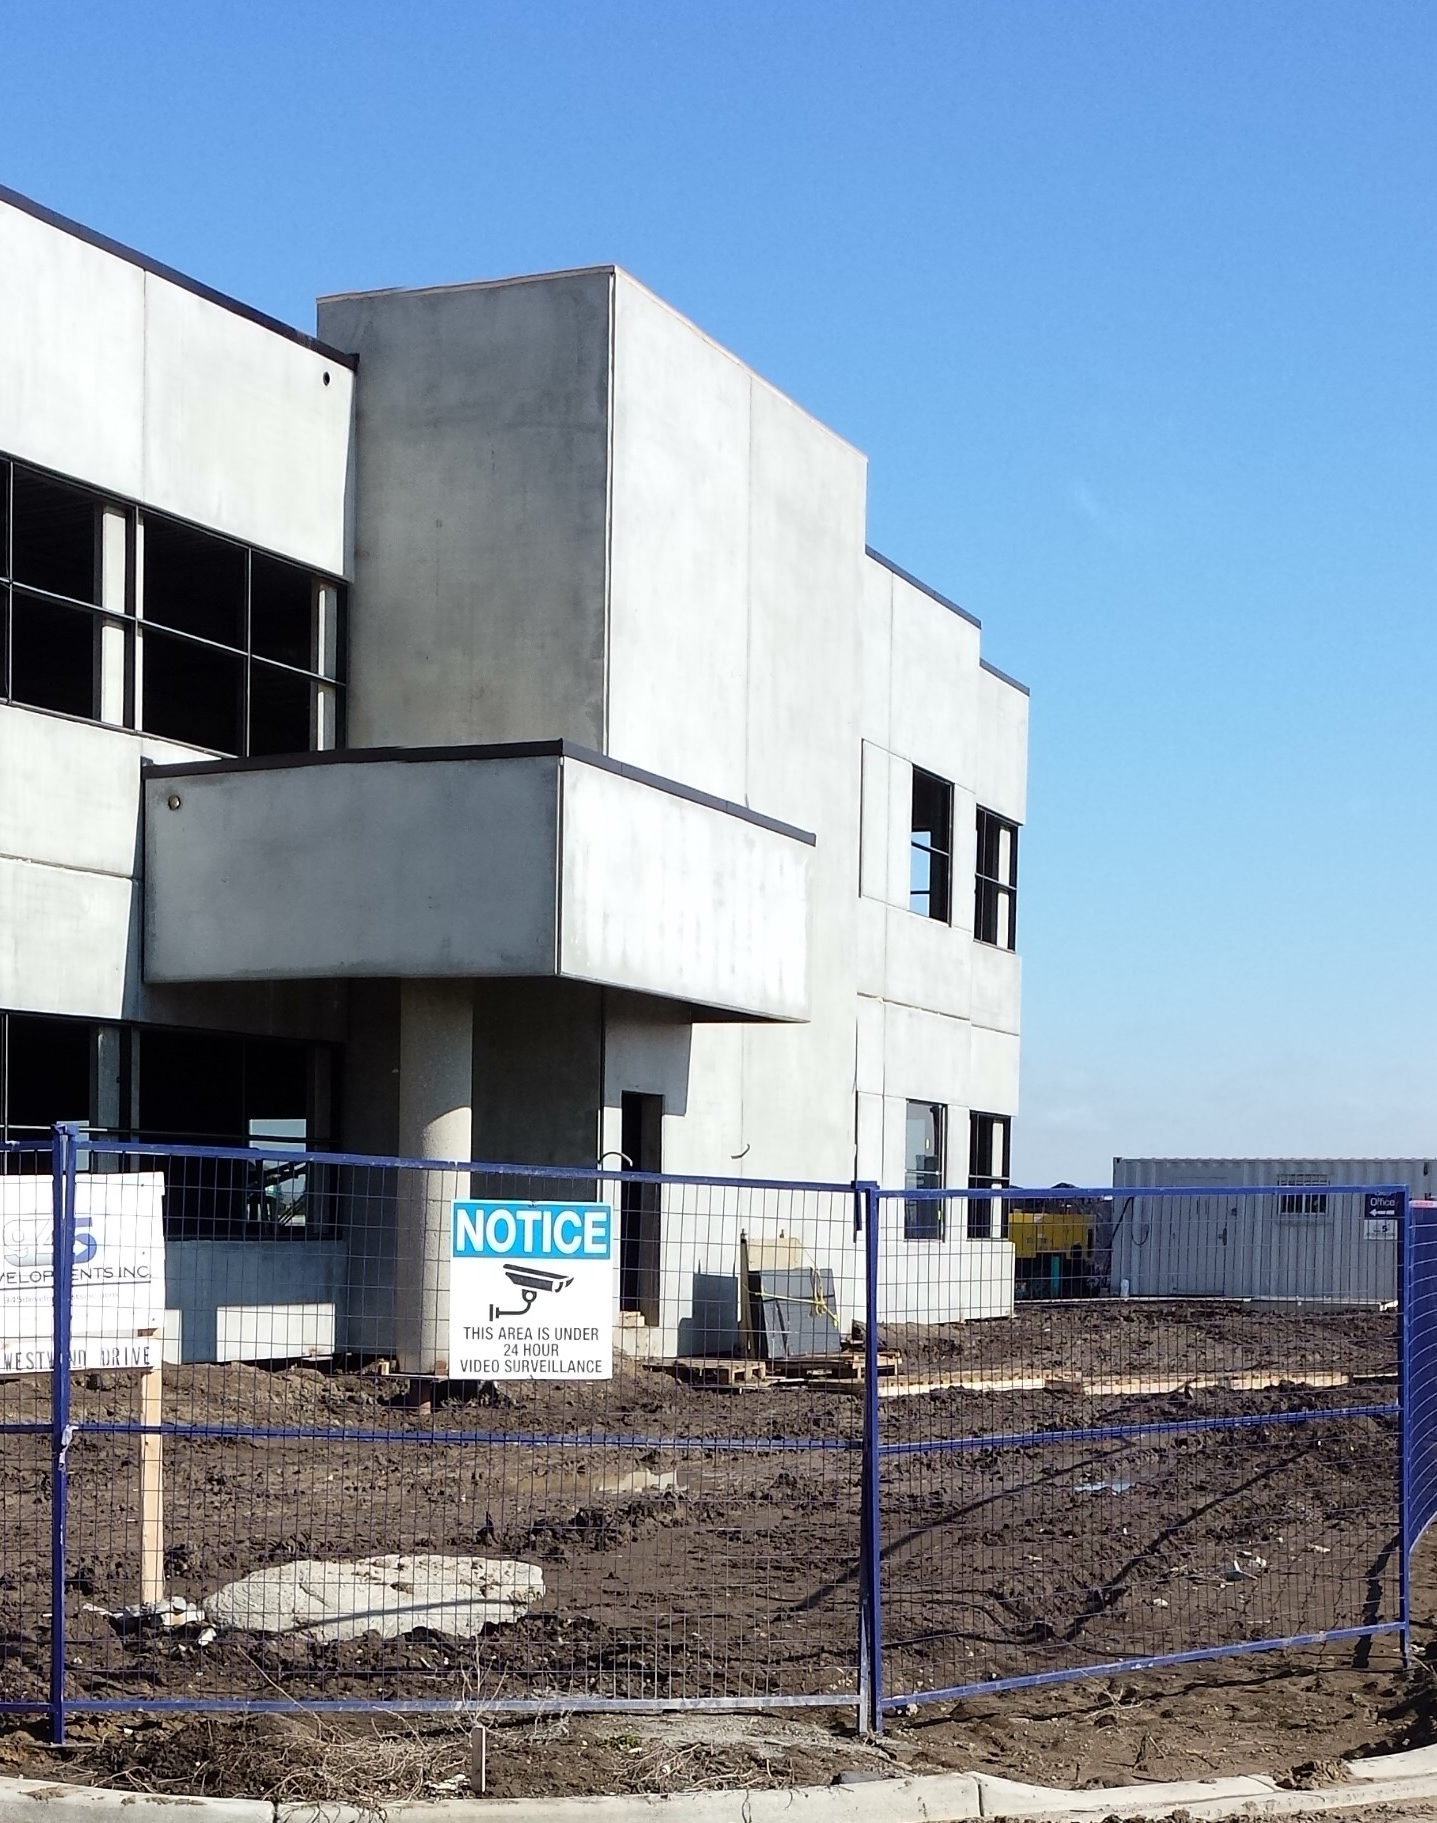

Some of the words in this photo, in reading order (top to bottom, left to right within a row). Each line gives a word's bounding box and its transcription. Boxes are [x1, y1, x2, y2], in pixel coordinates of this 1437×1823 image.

[456, 1208, 607, 1254] NOTICE
[464, 1327, 493, 1340] THIS
[498, 1328, 532, 1340] AREA
[538, 1328, 550, 1340] IS
[555, 1328, 599, 1341] UNDER
[504, 1344, 518, 1356] 24
[523, 1344, 559, 1357] HOUR
[4, 1350, 86, 1371] WESTWND
[101, 1347, 150, 1366] DRIVE
[460, 1360, 500, 1373] VIDEO
[505, 1360, 602, 1373] SURVEILLANCE
